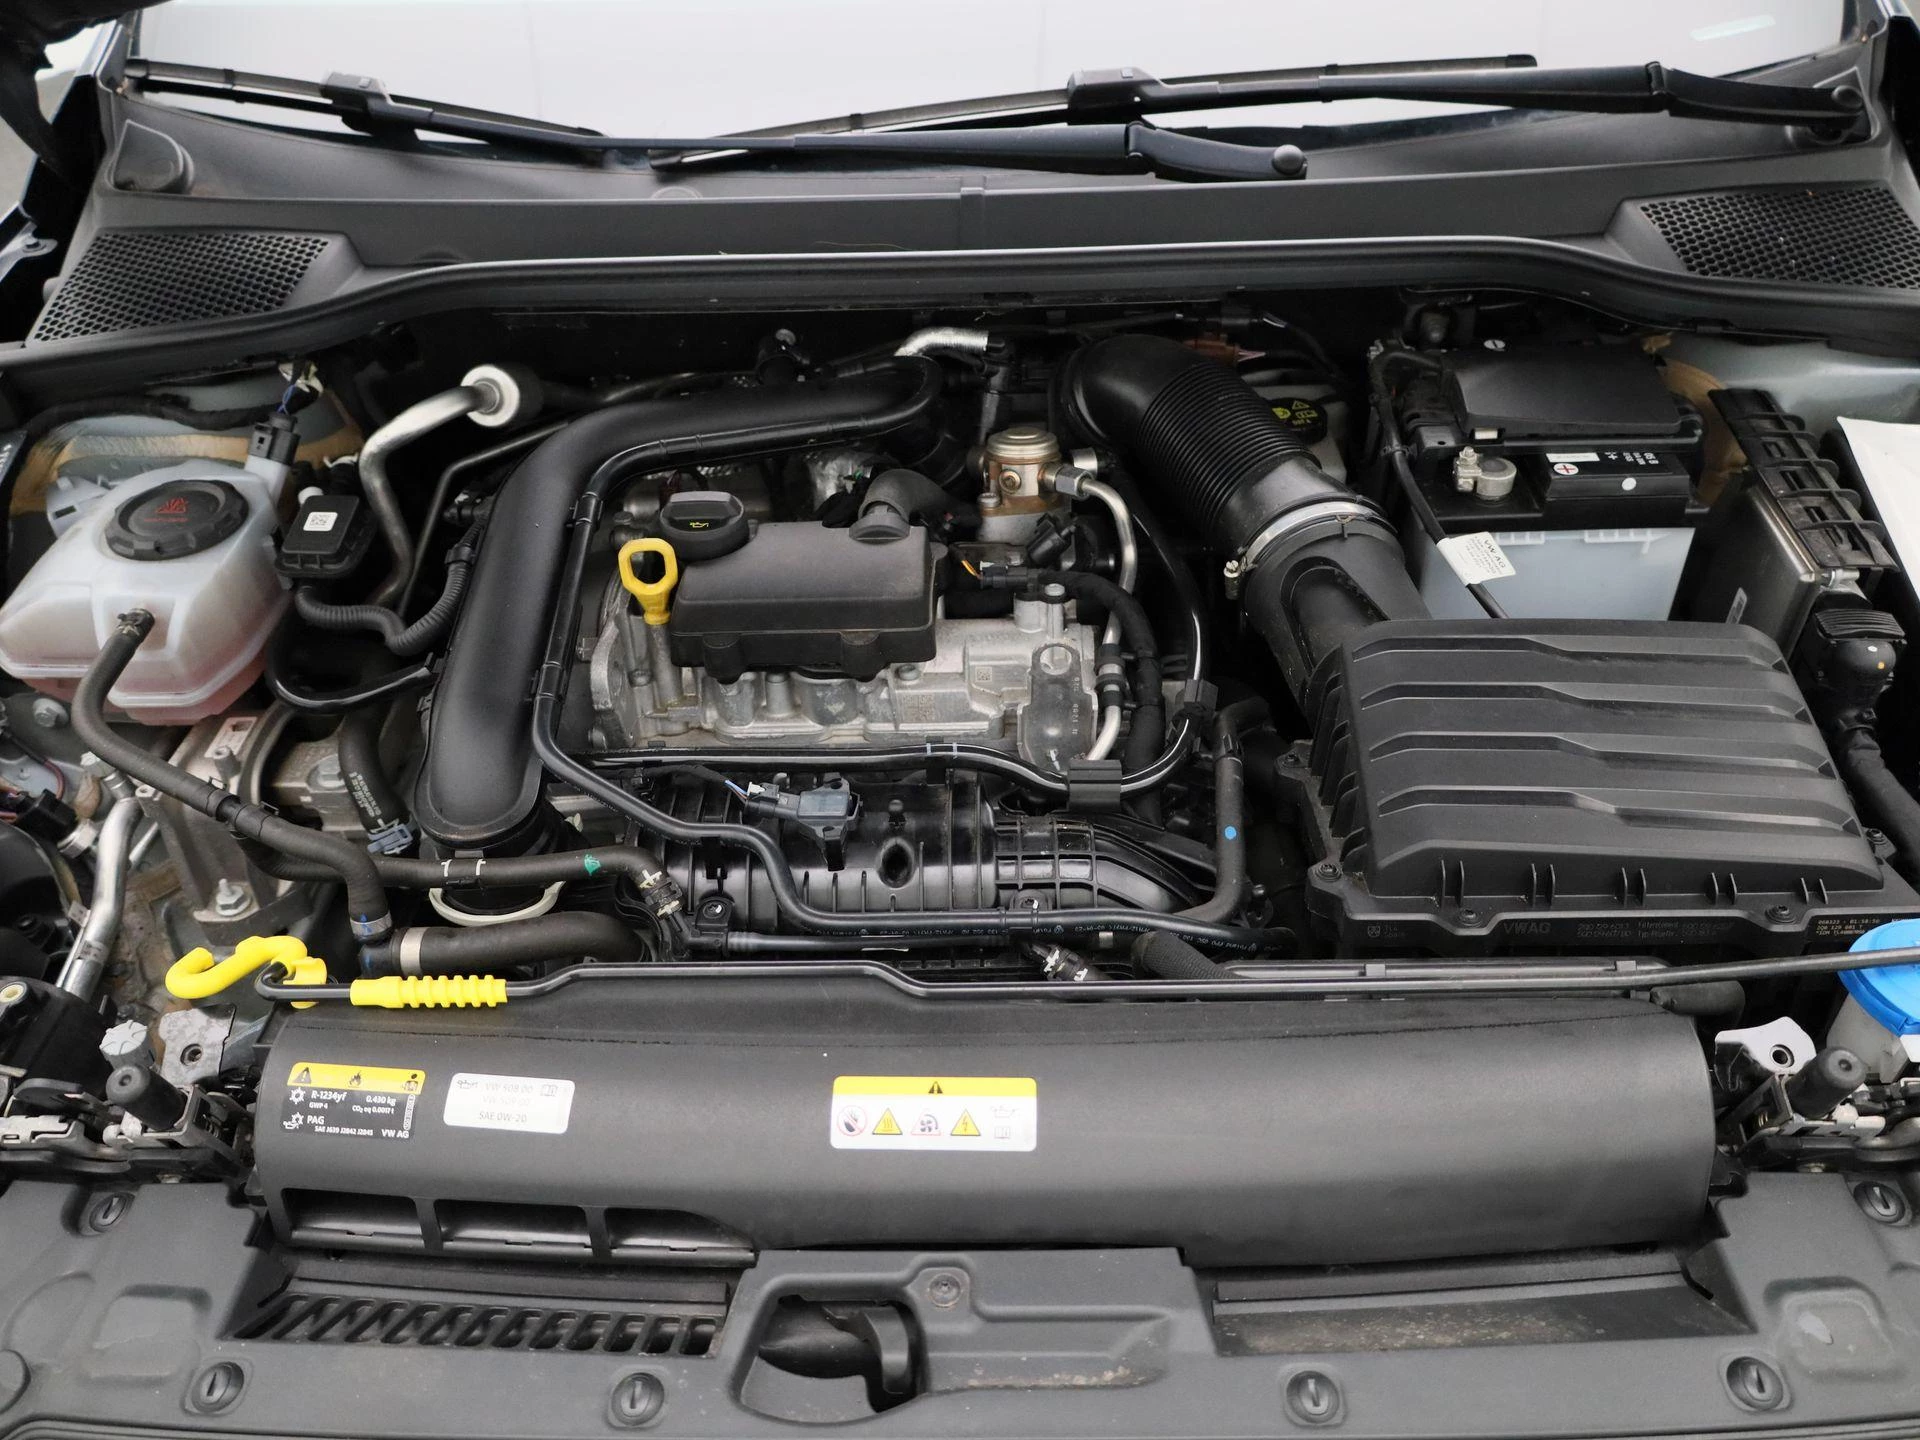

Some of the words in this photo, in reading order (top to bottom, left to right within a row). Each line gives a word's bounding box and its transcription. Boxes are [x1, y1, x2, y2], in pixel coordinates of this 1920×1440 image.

[485, 1083, 500, 1092] VW
[311, 1090, 347, 1103] R-1234yf
[386, 1096, 397, 1106] kg
[323, 1102, 328, 1110] 4
[307, 1115, 325, 1125] PAG
[479, 1111, 496, 1120] SAE
[496, 1112, 528, 1123] 0W-20
[315, 1125, 326, 1133] SAE
[381, 1129, 396, 1138] VW
[396, 1129, 410, 1139] AG
